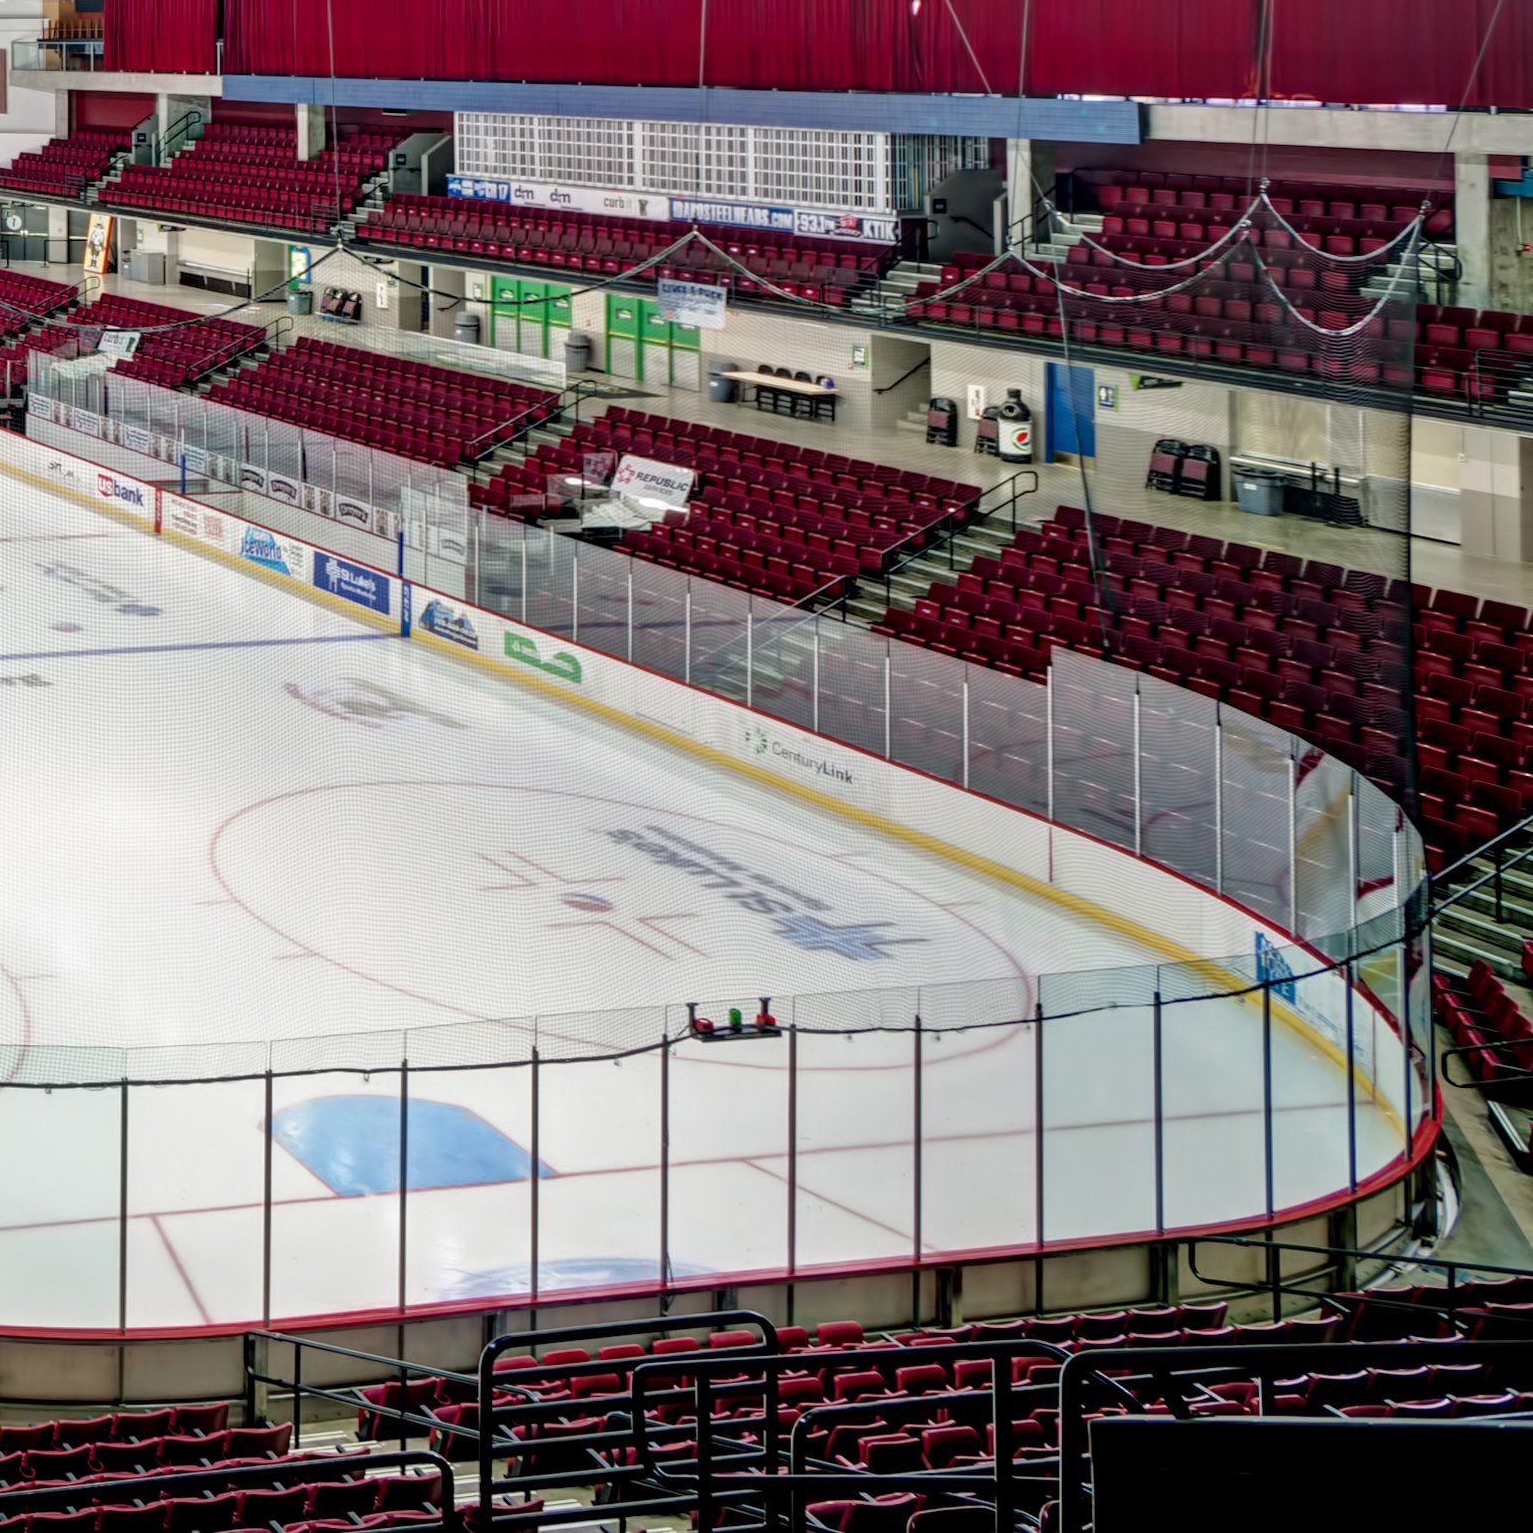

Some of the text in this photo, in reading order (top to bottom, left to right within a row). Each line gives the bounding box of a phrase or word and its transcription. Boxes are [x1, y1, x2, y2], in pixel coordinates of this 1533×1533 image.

[673, 200, 793, 229] IDAHOSTEELHEADS.COM
[863, 219, 896, 240] KTIK
[636, 472, 689, 491] REPUBLIC
[772, 741, 854, 785] CenturyLink
